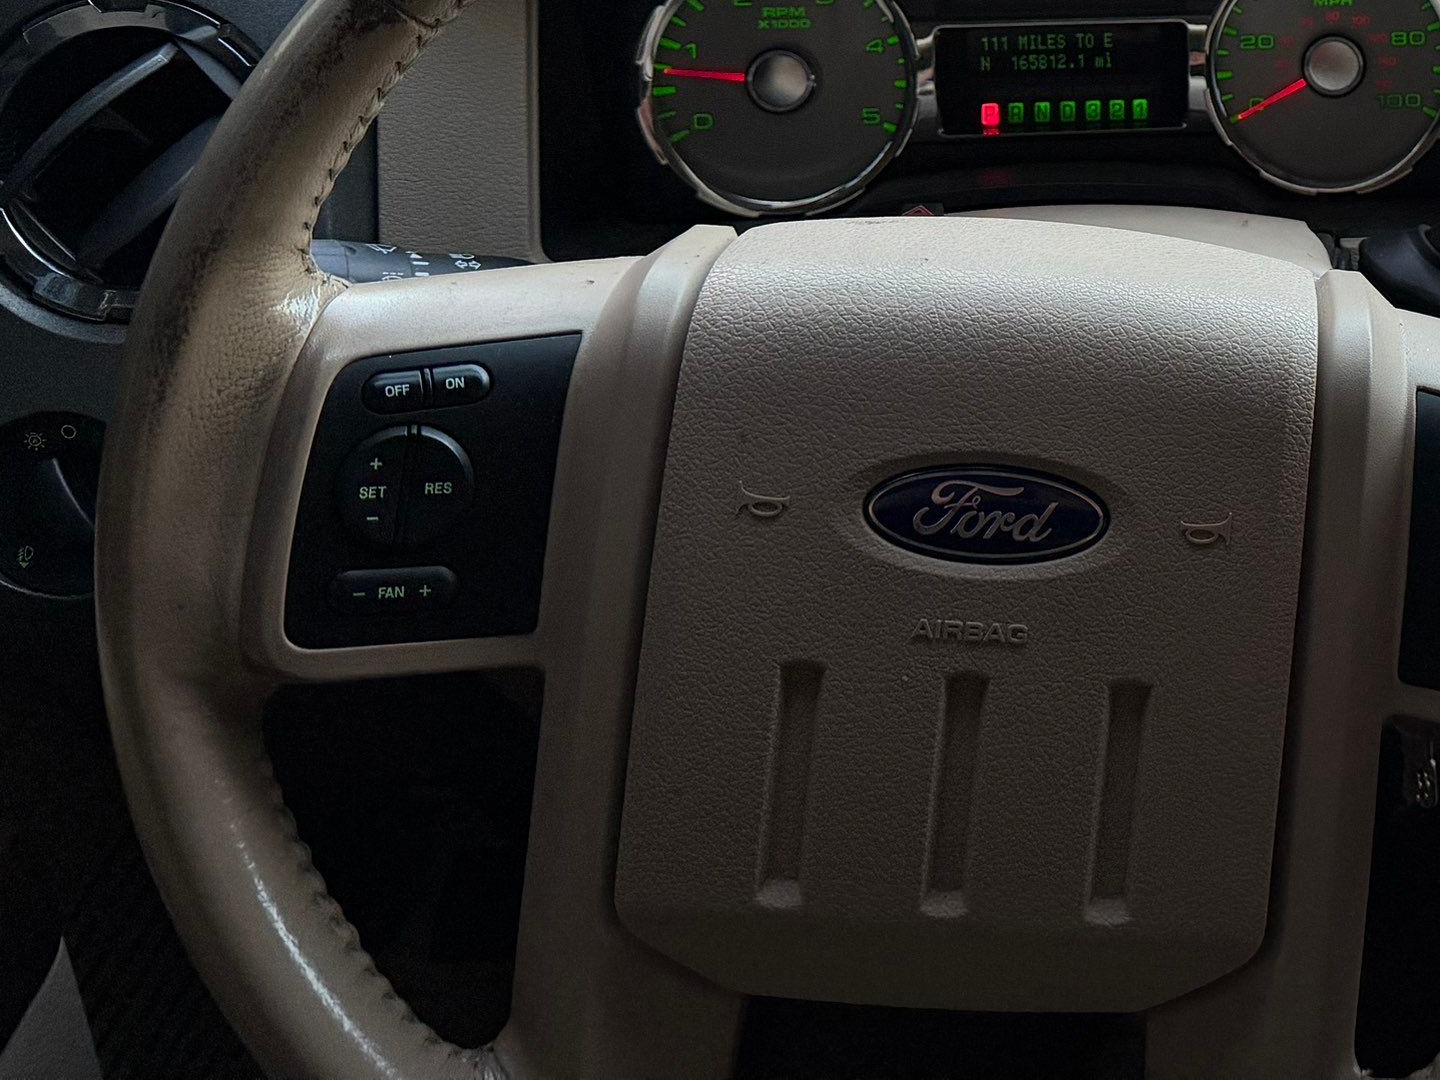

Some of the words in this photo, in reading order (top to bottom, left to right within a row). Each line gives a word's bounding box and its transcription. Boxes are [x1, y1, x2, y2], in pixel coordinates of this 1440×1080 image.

[761, 6, 806, 18] RPM
[865, 38, 885, 55] 4
[980, 35, 1009, 51] 111
[1017, 34, 1067, 50] MILES
[1076, 32, 1095, 49] TO
[1103, 32, 1114, 48] E
[1240, 34, 1275, 50] 20
[1390, 31, 1426, 47] 80
[683, 42, 698, 59] 1
[1011, 53, 1086, 71] 165812.1
[1378, 93, 1421, 108] 100
[861, 107, 881, 125] 5
[385, 383, 410, 398] OFF
[445, 376, 465, 391] ON
[359, 486, 387, 499] SET
[424, 482, 452, 495] RES
[912, 479, 1060, 543] Ford
[378, 586, 405, 599] FAN
[910, 617, 1030, 646] AIRBAG
